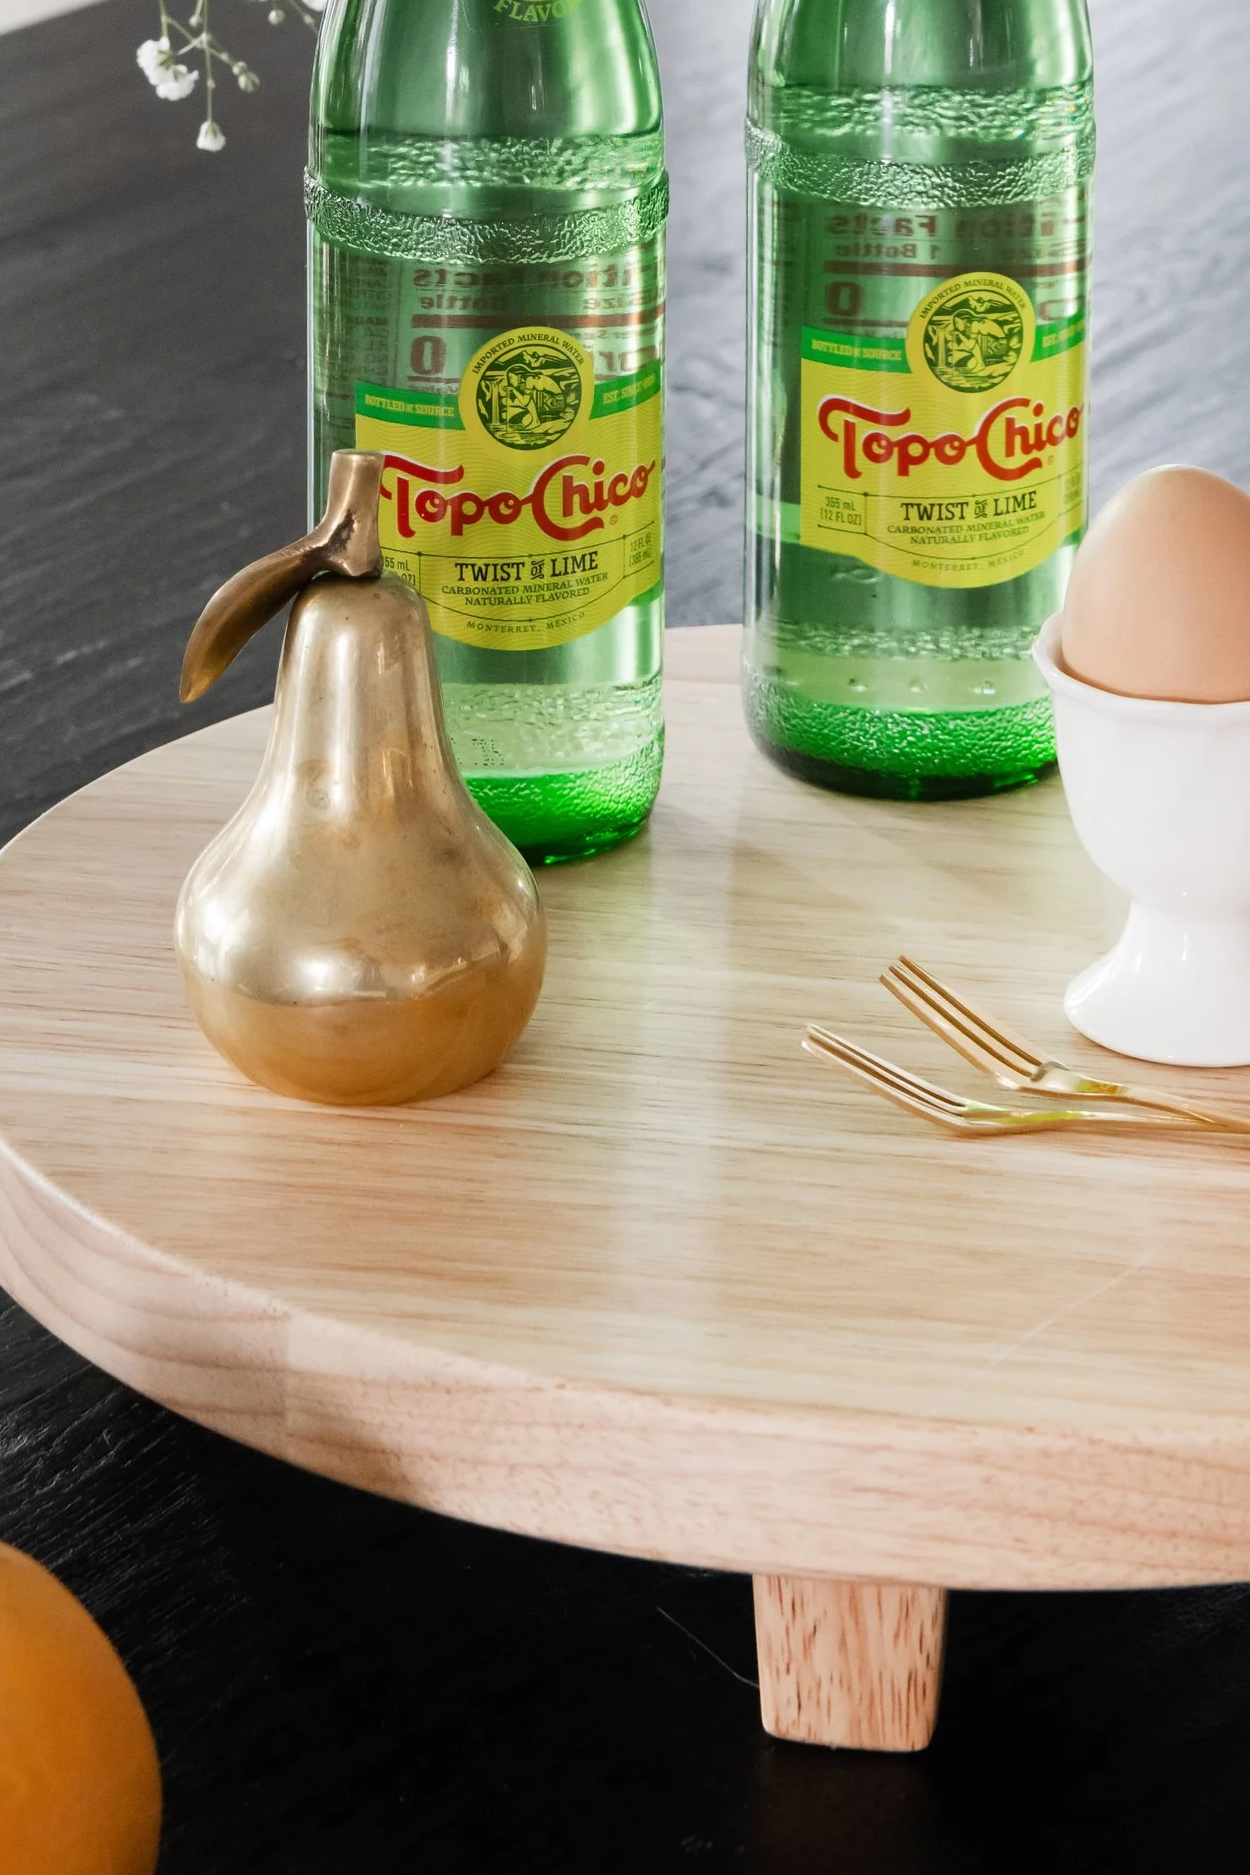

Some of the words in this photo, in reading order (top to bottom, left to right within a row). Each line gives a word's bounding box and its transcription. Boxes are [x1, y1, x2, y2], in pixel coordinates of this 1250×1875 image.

[920, 283, 962, 320] IMPORTED
[963, 278, 1004, 290] MINERAL
[1005, 286, 1026, 310] WATER
[472, 338, 515, 375] IMPORTED
[517, 333, 561, 345] MINERAL
[563, 340, 585, 366] WATER
[365, 394, 405, 412] BOTTLED
[415, 405, 454, 417] SOURCE
[818, 398, 969, 479] Topo
[976, 397, 1084, 482] Chico
[379, 454, 523, 539] Topo
[531, 454, 656, 541] Chico
[900, 502, 969, 521] TWIST
[974, 499, 989, 519] OF
[993, 491, 1037, 516] LIME
[835, 511, 846, 523] FL
[887, 525, 963, 535] CARBONATED
[966, 520, 1014, 533] MINERAL
[1016, 511, 1046, 525] WATER
[910, 533, 976, 545] NATURALLY
[978, 526, 1030, 541] FLAVORED
[397, 560, 410, 571] mL
[454, 562, 525, 582] TWIST
[530, 559, 546, 580] OF
[550, 551, 598, 577] LIME
[441, 585, 520, 595] CARBONATED
[522, 581, 572, 594] MINERAL
[575, 572, 608, 587] WATER
[464, 595, 533, 606] NATURALLY
[535, 587, 590, 603] FLAVORED
